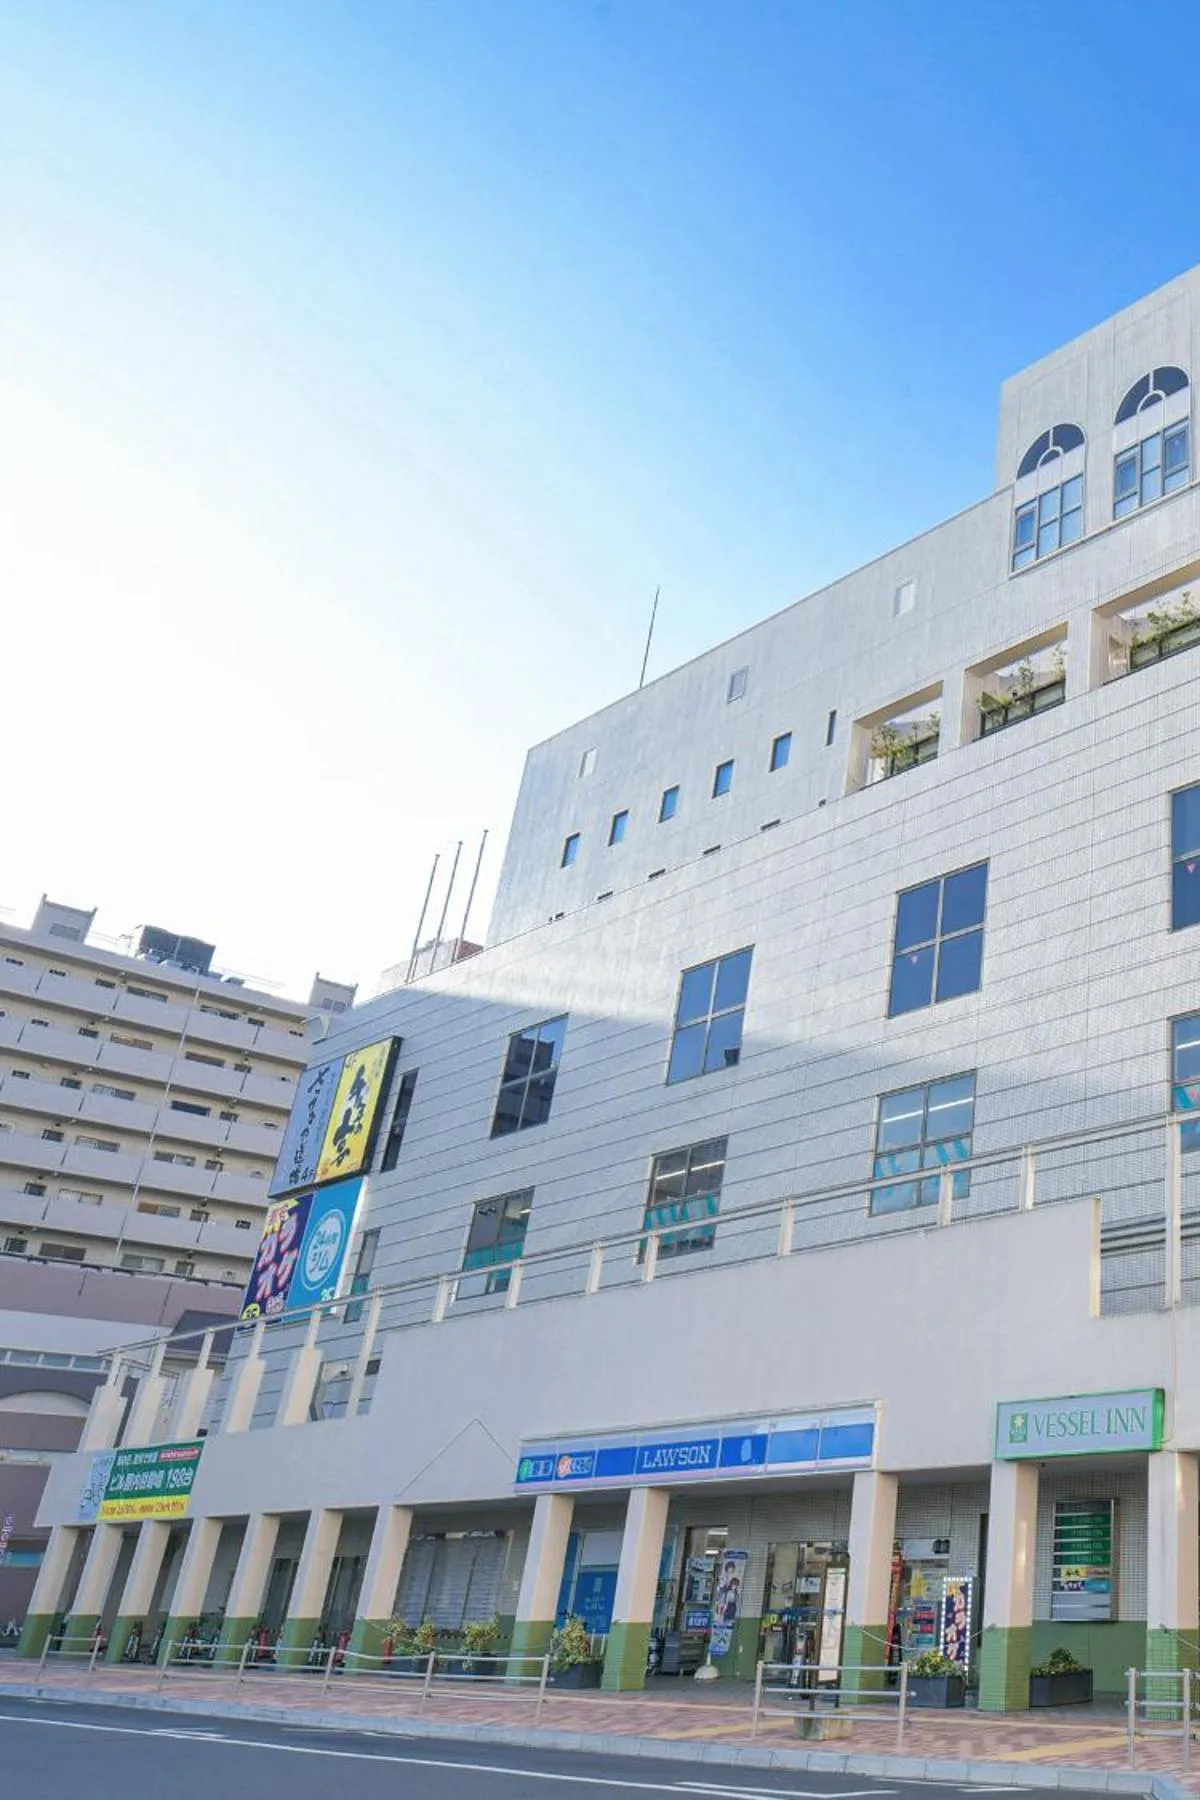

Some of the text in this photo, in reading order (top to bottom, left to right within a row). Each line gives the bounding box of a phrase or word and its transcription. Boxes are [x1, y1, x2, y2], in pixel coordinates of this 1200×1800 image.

[1034, 1409, 1100, 1438] VESSEL
[1102, 1406, 1147, 1435] INN
[643, 1446, 711, 1468] LAWSON
